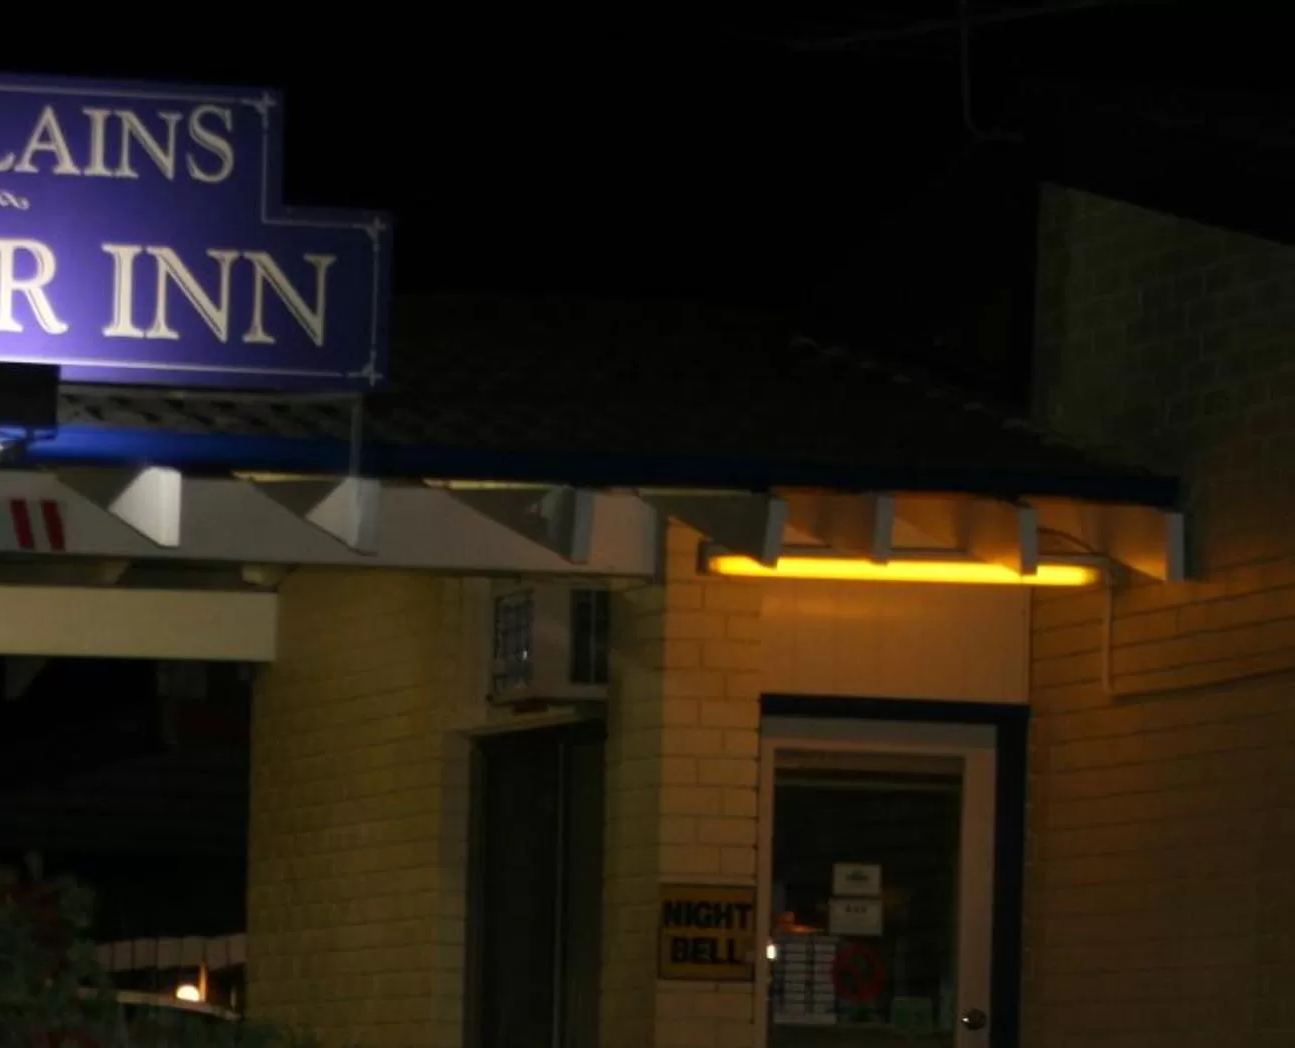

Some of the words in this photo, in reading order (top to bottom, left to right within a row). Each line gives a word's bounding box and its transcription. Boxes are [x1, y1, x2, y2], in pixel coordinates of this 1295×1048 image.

[101, 242, 337, 347] INN
[662, 900, 754, 930] NIGHT
[671, 936, 744, 965] BELL
